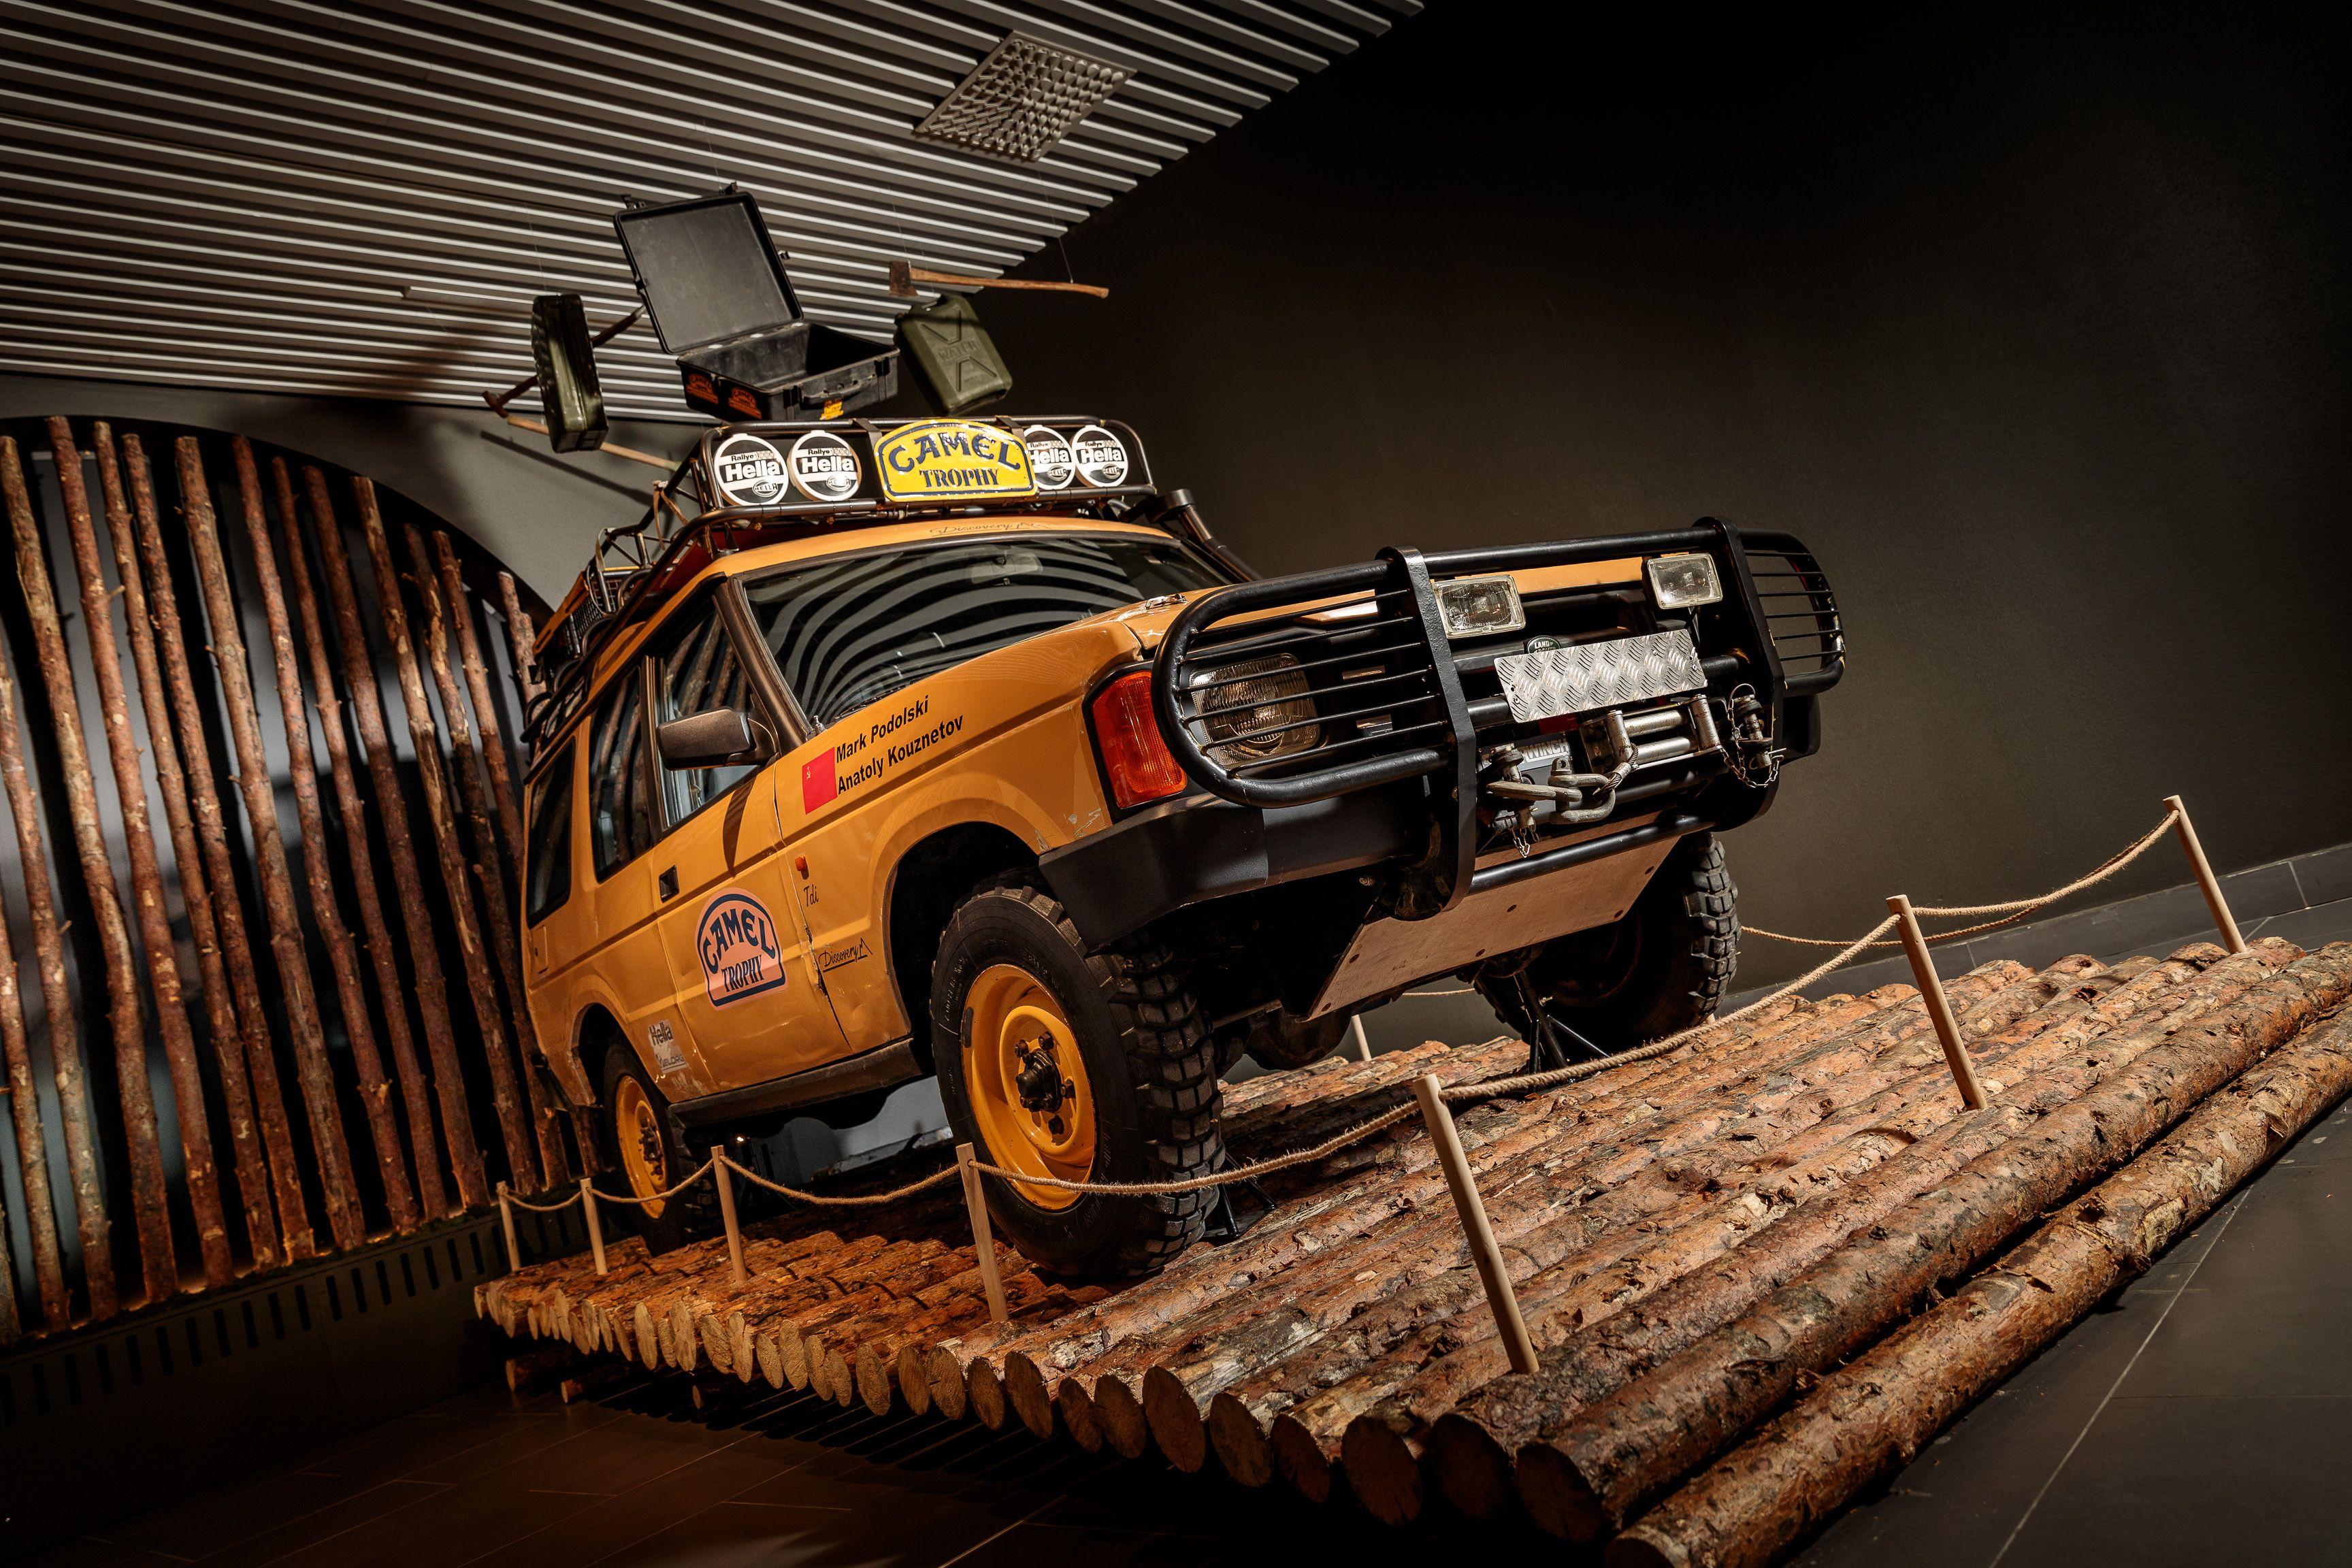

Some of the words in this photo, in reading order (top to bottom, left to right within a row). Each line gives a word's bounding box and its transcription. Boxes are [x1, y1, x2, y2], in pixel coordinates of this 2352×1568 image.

[731, 453, 754, 462] Rallye
[888, 431, 1021, 472] CAMEL
[1028, 448, 1070, 465] Hella
[1081, 447, 1122, 464] Hella
[725, 459, 781, 482] Hella
[801, 455, 855, 474] Hella
[919, 468, 999, 488] TROPHY
[930, 523, 1013, 536] Discovery
[1534, 640, 1550, 649] LAND
[836, 734, 866, 764] Mark
[870, 695, 929, 744] Podolski
[838, 757, 884, 795] Anatoly
[887, 715, 964, 767] Kouznetov
[804, 884, 819, 907] Tdi
[702, 908, 776, 974] CAMEL
[818, 945, 858, 967] Discovery
[721, 955, 765, 993] TROPHY
[649, 1022, 674, 1046] Hella
